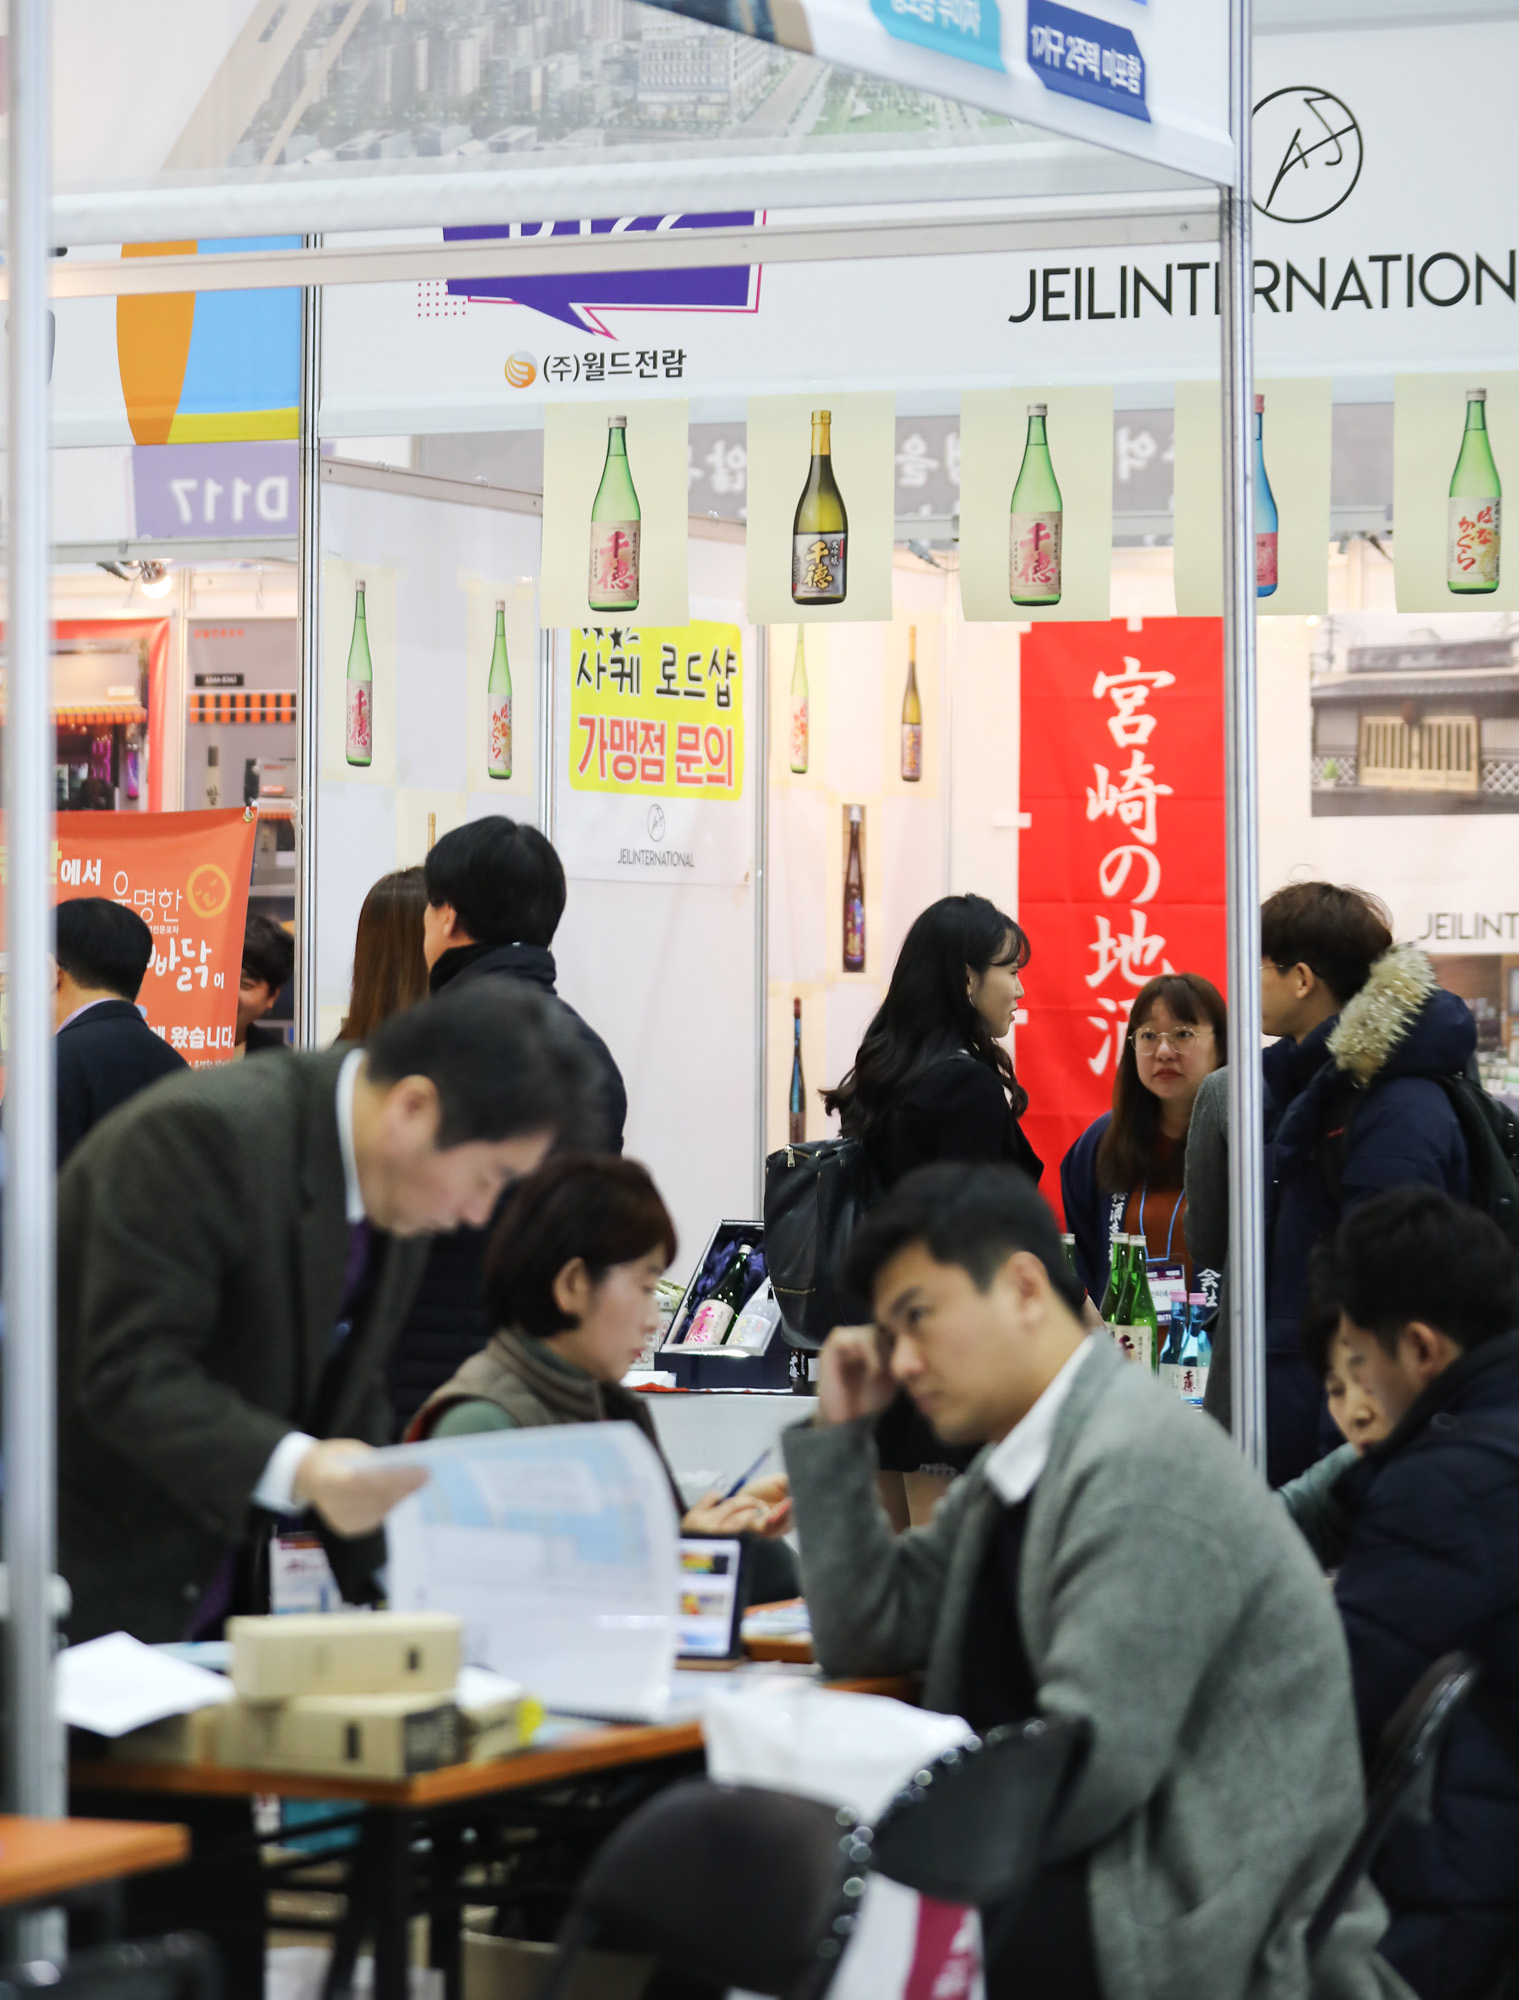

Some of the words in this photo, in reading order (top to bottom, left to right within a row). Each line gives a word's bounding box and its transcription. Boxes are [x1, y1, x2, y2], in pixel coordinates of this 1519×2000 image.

[1102, 47, 1142, 95] 미포함
[1008, 250, 1517, 323] JEILINTRNATION
[543, 349, 687, 383] (주)월드전람
[576, 651, 640, 694] 사케
[656, 645, 736, 708] 로드샵
[578, 716, 665, 783] 가맹점
[676, 724, 733, 787] 문의
[170, 1025, 234, 1049] 왔습니다.
